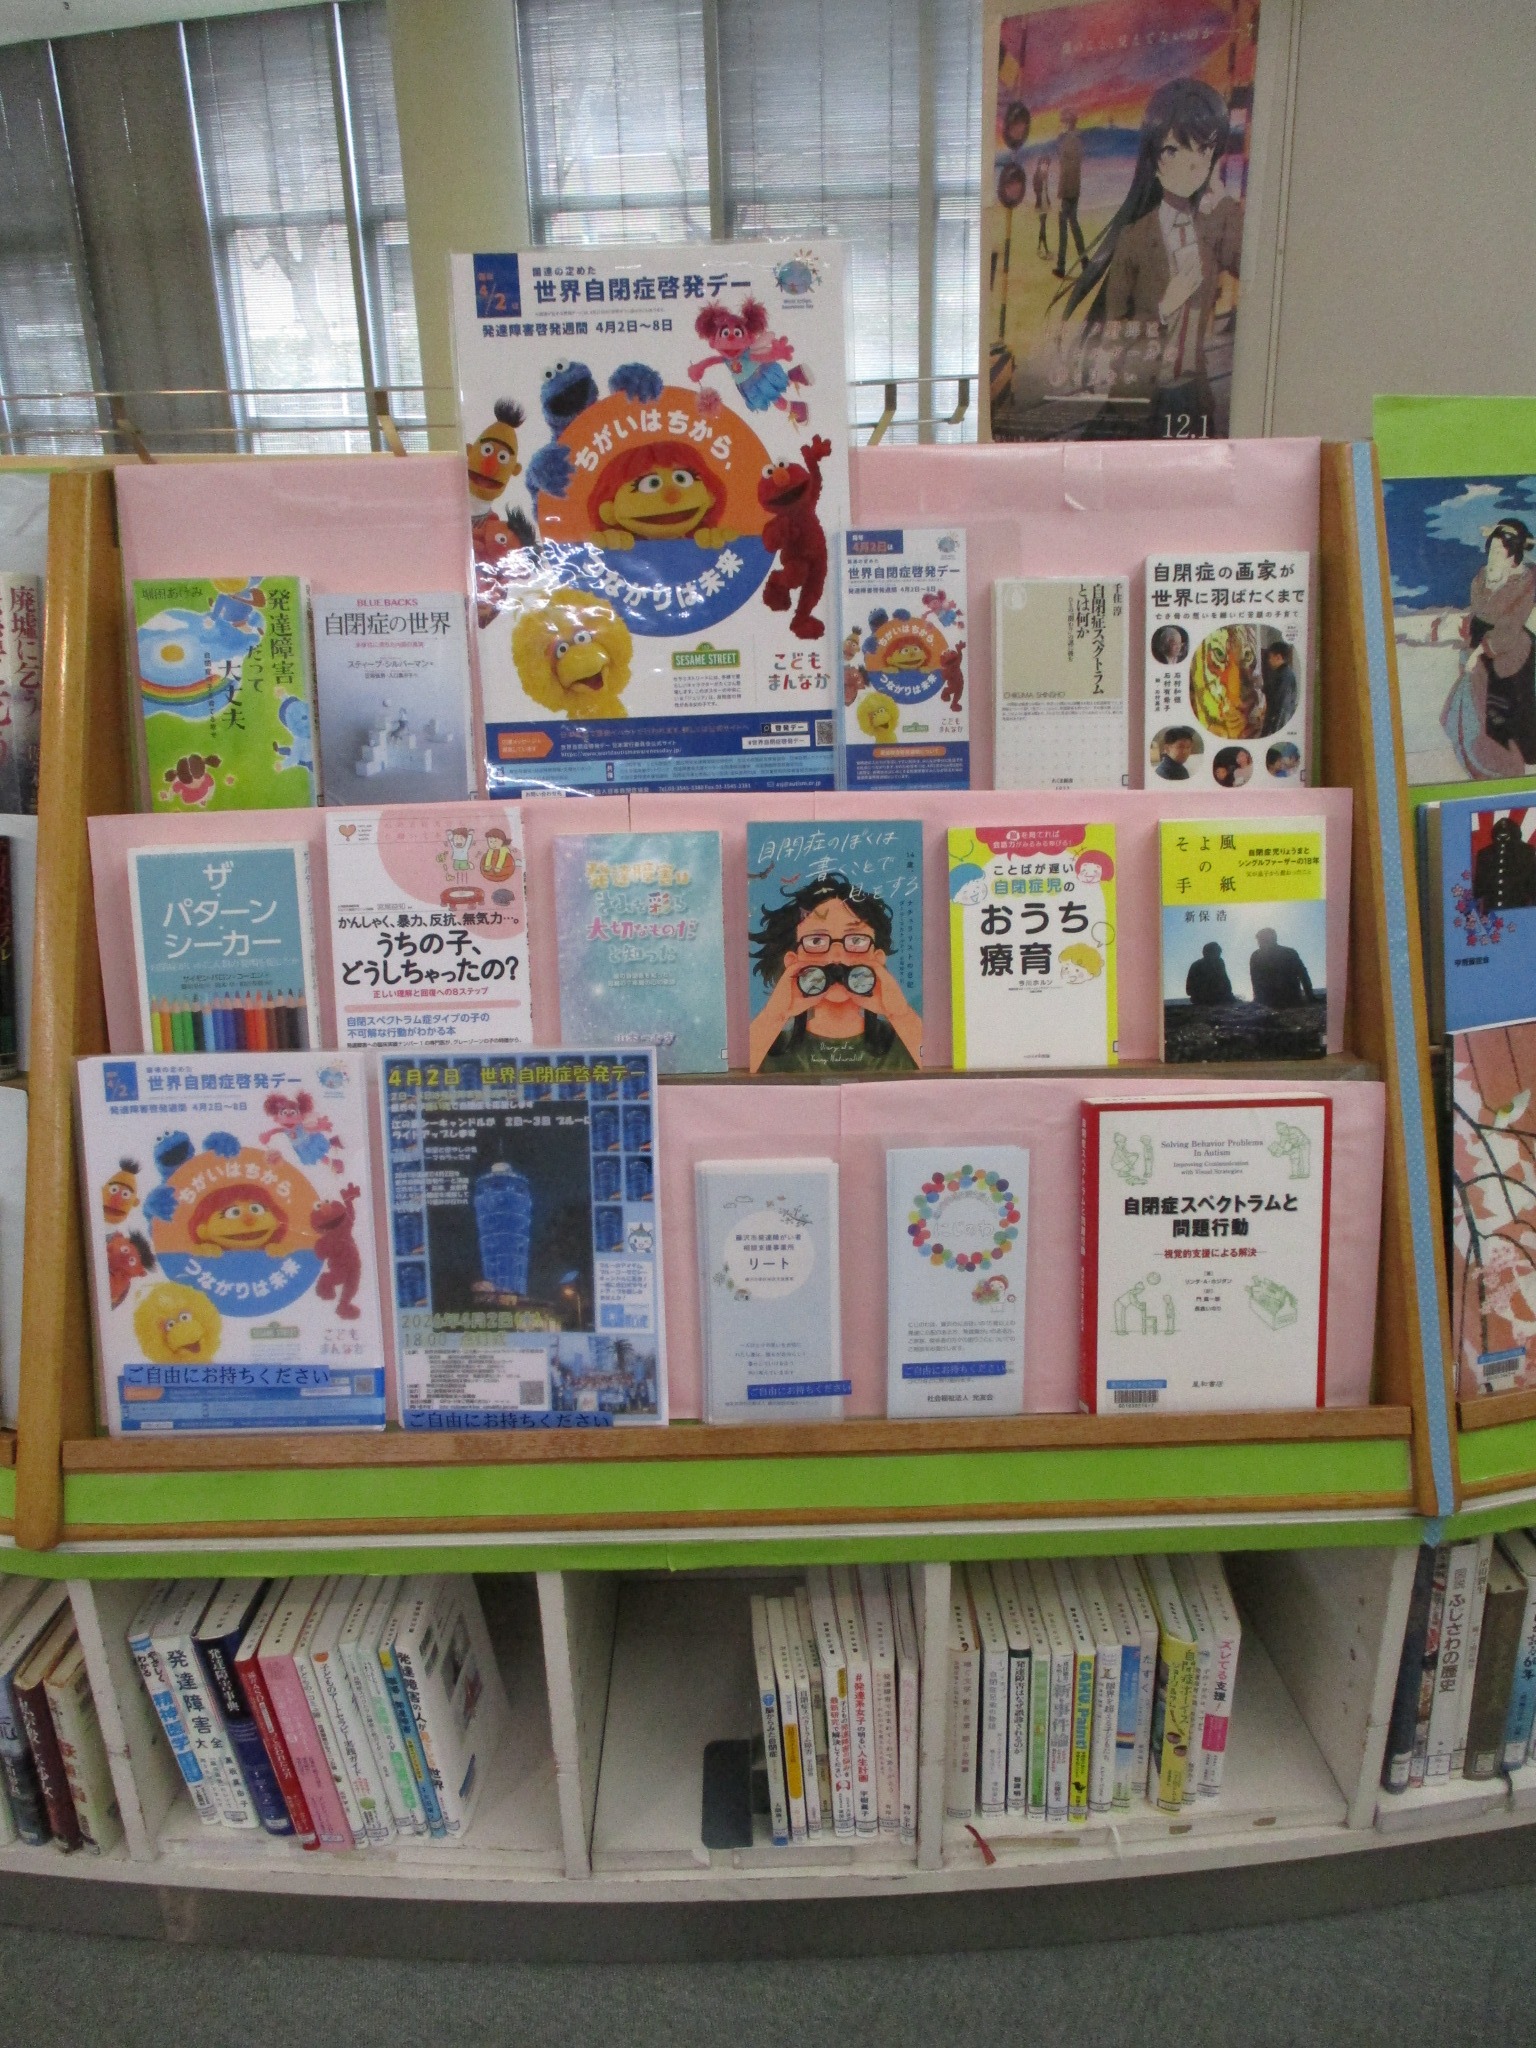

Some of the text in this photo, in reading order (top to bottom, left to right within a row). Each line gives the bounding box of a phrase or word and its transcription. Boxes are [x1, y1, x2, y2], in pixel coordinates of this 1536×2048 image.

[533, 272, 752, 304] 世界自閉症啓発デー
[482, 321, 588, 338] 発達障害啓発週間
[1161, 414, 1211, 440] 12.1
[574, 408, 734, 473] ちがいはちから、
[847, 565, 961, 580] 世界自閉症啓発デー
[1154, 559, 1295, 583] 自閉症の画家が
[356, 598, 418, 607] BLUE BACKS
[1151, 588, 1306, 608] 世界に羽ばたくまで
[1076, 583, 1090, 639] とは何か
[325, 611, 451, 636] 自閉症の世界
[268, 588, 295, 685] 発達障害
[1091, 583, 1106, 695] 自閉症スペクトラム
[10, 586, 40, 717] 廃墟に乞う
[675, 652, 737, 667] SESAME STREET
[774, 651, 821, 671] こども
[246, 644, 265, 693] だって
[768, 673, 831, 691] まんなか
[877, 673, 938, 696] つながりは未来
[217, 660, 246, 731] 大丈夫
[774, 722, 805, 732] 啓発デー
[757, 828, 899, 864] 自閉症のぼくは
[805, 854, 896, 883] 書くことで
[993, 862, 1074, 876] ことばが遅い
[1238, 857, 1320, 868] シングルファーザーの18年
[585, 859, 690, 890] 発達障害は
[994, 877, 1075, 895] 自閉症児の
[587, 916, 699, 941] 大切なものだ
[979, 900, 1090, 936] おうち
[164, 929, 282, 959] シーカー
[377, 929, 482, 958] うちの子、
[342, 955, 519, 986] どうしちゃったの?
[979, 941, 1052, 977] 療育
[373, 986, 489, 999] 正しい理解と回復への8ステップ
[347, 1012, 490, 1027] 自閉スペクトラム症タイプの子の
[347, 1025, 457, 1038] 不可解な行動がわかる本
[147, 1072, 303, 1092] 世界自閉症啓発デー
[388, 1064, 647, 1087] 4月2日 世界自閉症啓発デー
[1161, 1138, 1264, 1149] Solving Behavior Problems
[1193, 1149, 1202, 1157] In
[1123, 1193, 1299, 1216] 自閉症スペクトラムと
[1172, 1217, 1250, 1238] 問題行動
[749, 1257, 789, 1271] リート
[185, 1257, 301, 1300] つながりは未来
[127, 1365, 330, 1386] ご自由にお持ちください
[905, 1363, 1005, 1377] ご自由にお持ちください
[750, 1383, 851, 1398] ご自由にお持ちください
[408, 1411, 610, 1429] ご自由にお持ちください
[167, 1649, 212, 1734] 発達障害
[195, 1737, 224, 1749] 大全
